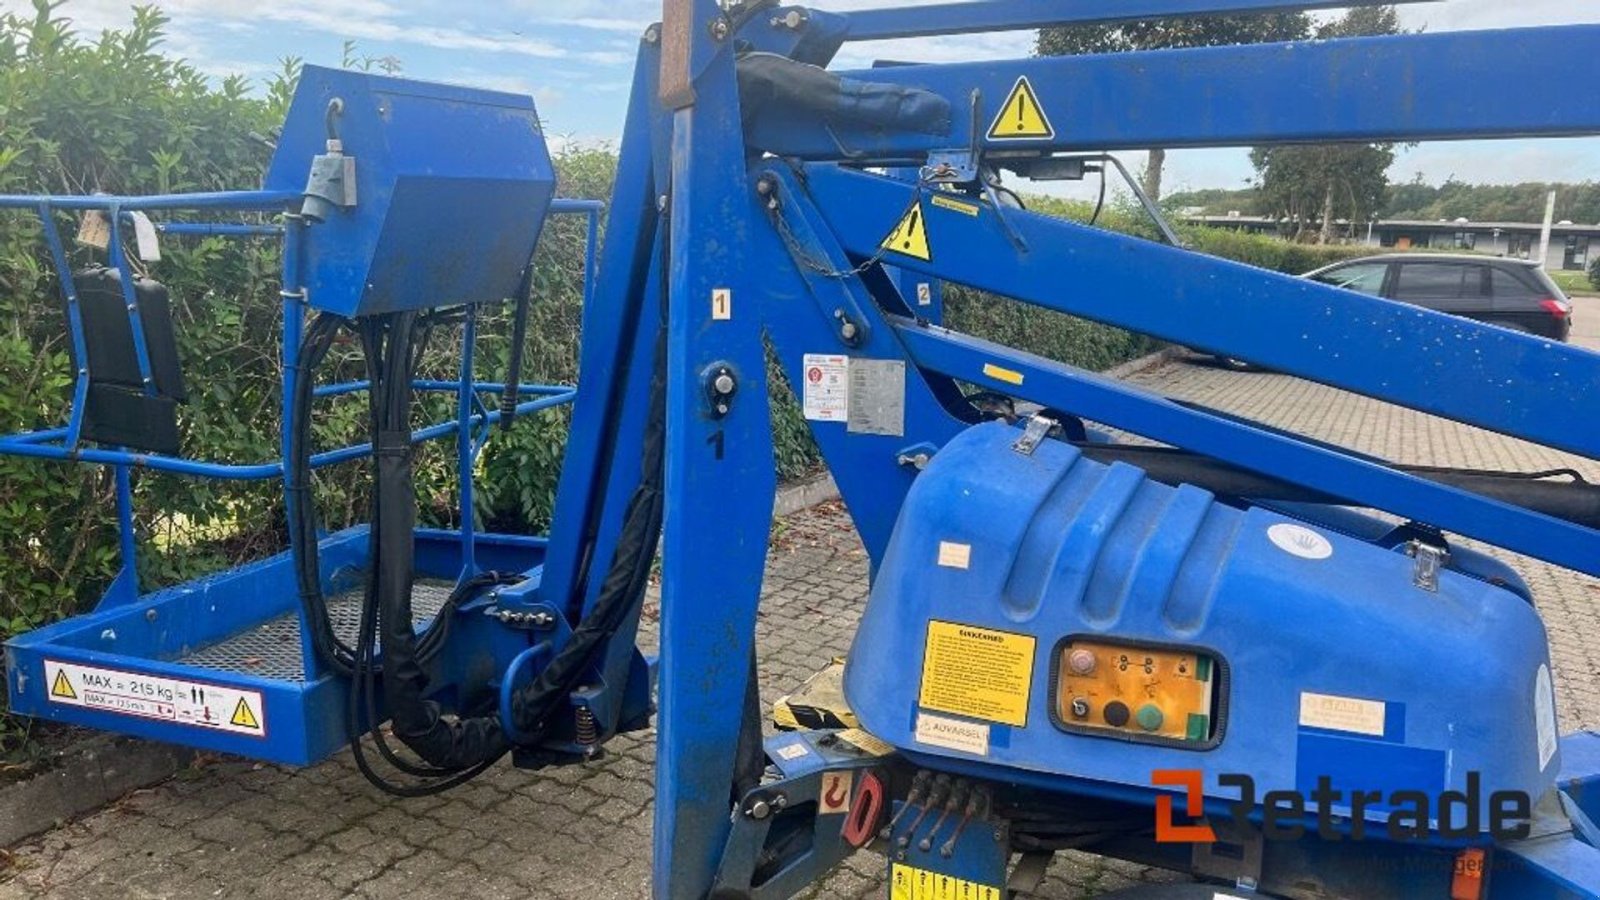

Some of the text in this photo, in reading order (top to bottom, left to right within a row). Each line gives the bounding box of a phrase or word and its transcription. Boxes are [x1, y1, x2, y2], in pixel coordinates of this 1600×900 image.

[715, 293, 725, 314] 1
[919, 286, 928, 301] 2
[707, 430, 725, 460] 1
[82, 673, 112, 689] MAX
[130, 681, 154, 696] 215
[158, 684, 173, 701] kg
[87, 694, 105, 704] MAX
